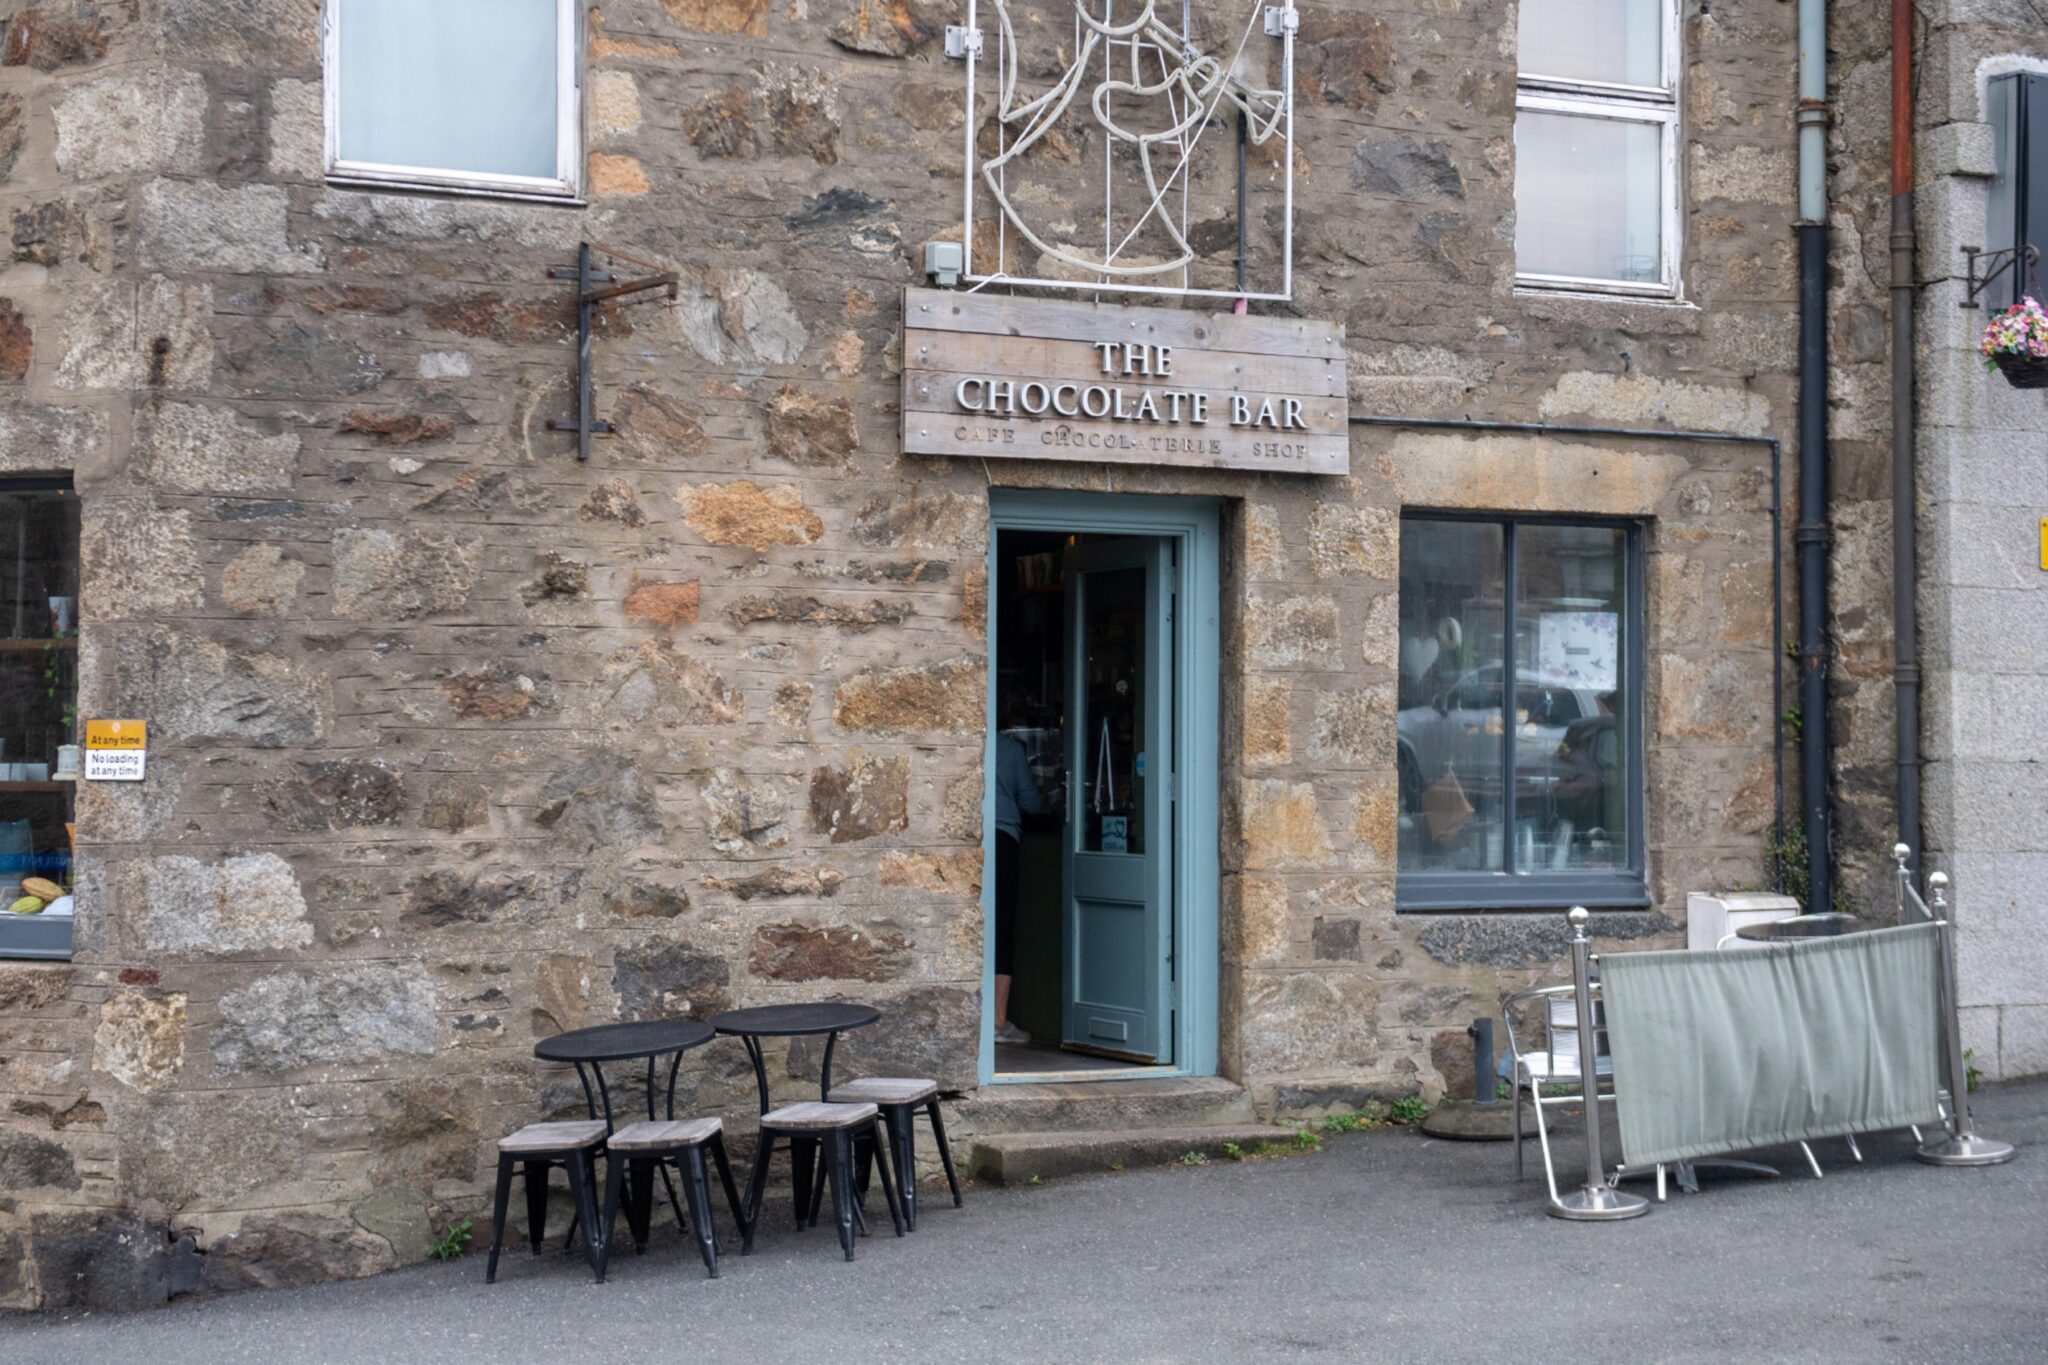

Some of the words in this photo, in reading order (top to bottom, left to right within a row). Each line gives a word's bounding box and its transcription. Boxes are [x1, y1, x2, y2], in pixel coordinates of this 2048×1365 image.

[1095, 342, 1172, 376] THE
[955, 379, 1208, 423] CHOCOLATE
[1229, 394, 1308, 429] BAR
[954, 426, 1015, 444] CAFE
[1252, 442, 1306, 459] SHOP
[91, 735, 102, 745] At
[103, 736, 118, 746] any
[120, 735, 140, 745] time
[91, 754, 105, 764] No
[106, 754, 138, 765] loading
[91, 767, 101, 776] at
[102, 767, 117, 777] any
[119, 767, 138, 776] time
